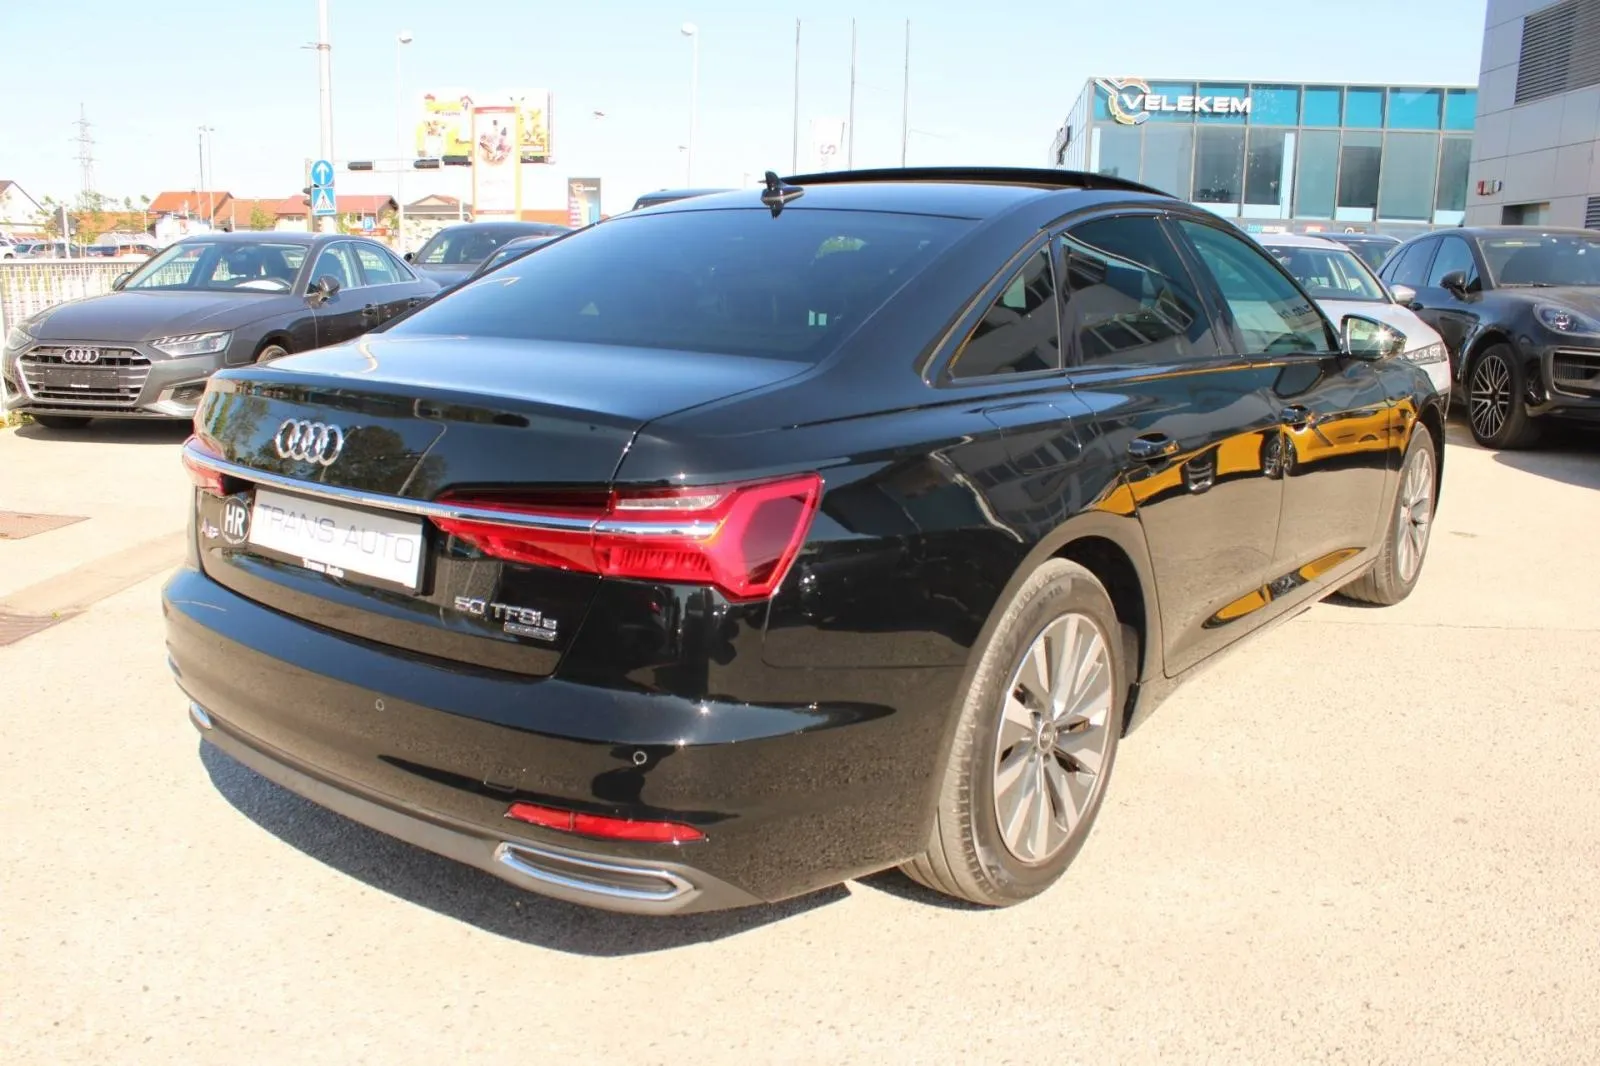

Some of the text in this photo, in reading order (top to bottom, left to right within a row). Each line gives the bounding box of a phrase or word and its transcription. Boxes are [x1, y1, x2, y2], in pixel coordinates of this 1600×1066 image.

[1122, 94, 1252, 113] VELEKEM
[224, 503, 246, 537] HR
[259, 502, 415, 564] TRANS AUTO
